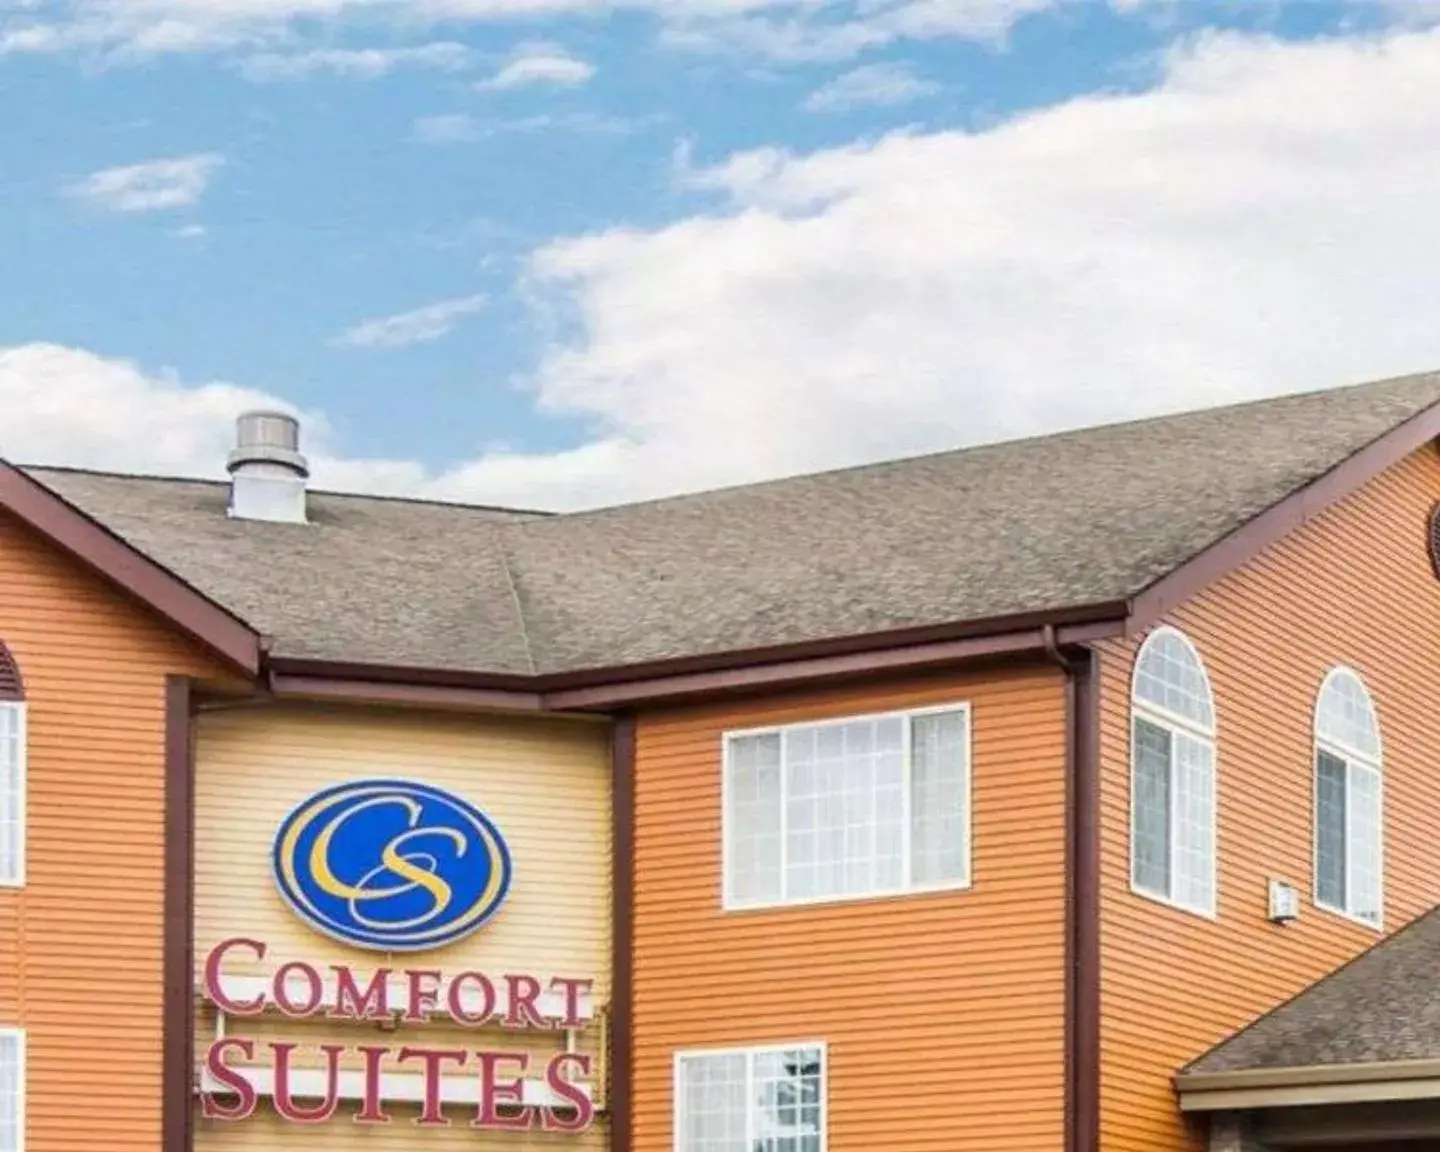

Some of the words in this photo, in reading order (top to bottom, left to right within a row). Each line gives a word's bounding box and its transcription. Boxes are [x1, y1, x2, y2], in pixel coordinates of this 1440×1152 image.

[308, 794, 468, 930] CS
[203, 936, 594, 1030] COMFORT
[201, 1036, 596, 1133] SUITES
